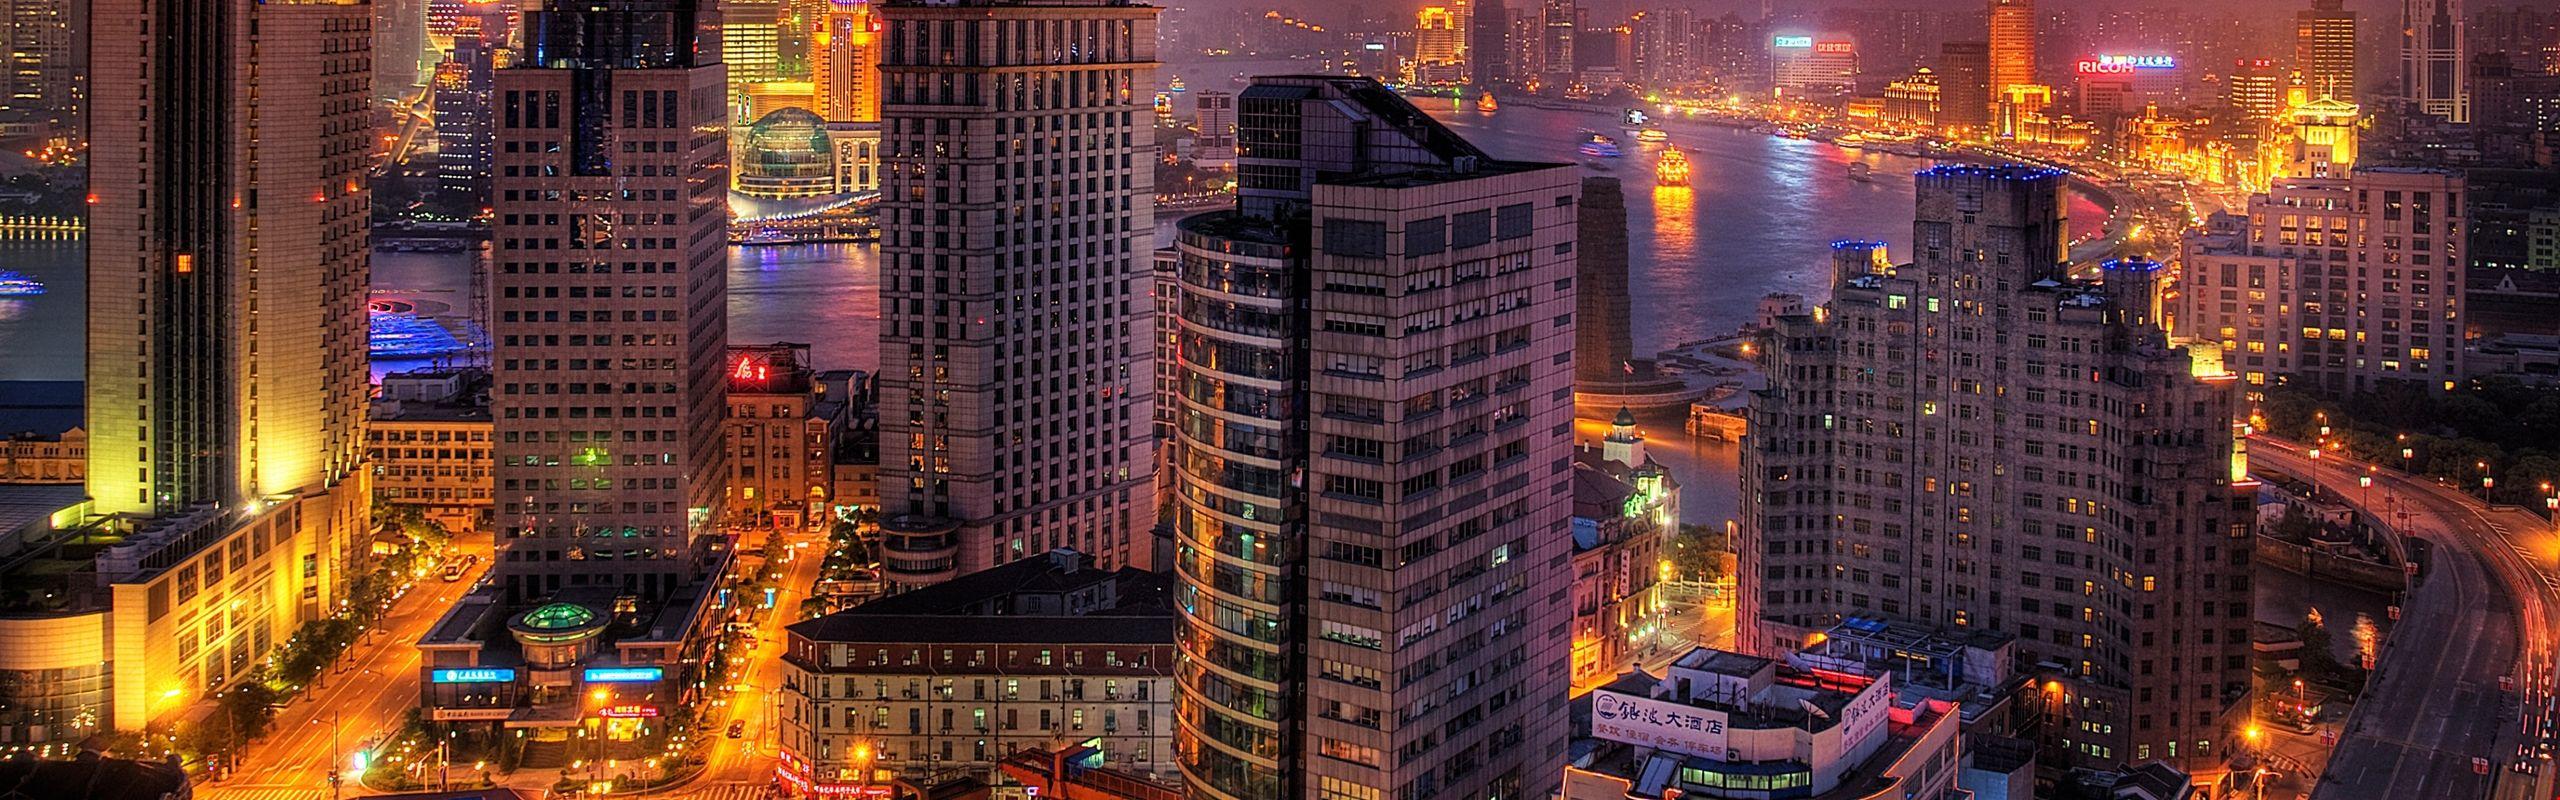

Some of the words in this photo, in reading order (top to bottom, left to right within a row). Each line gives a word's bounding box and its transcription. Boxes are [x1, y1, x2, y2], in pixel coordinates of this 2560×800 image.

[2079, 61, 2134, 73] RICOH
[1618, 701, 1723, 735] 银波大酒店
